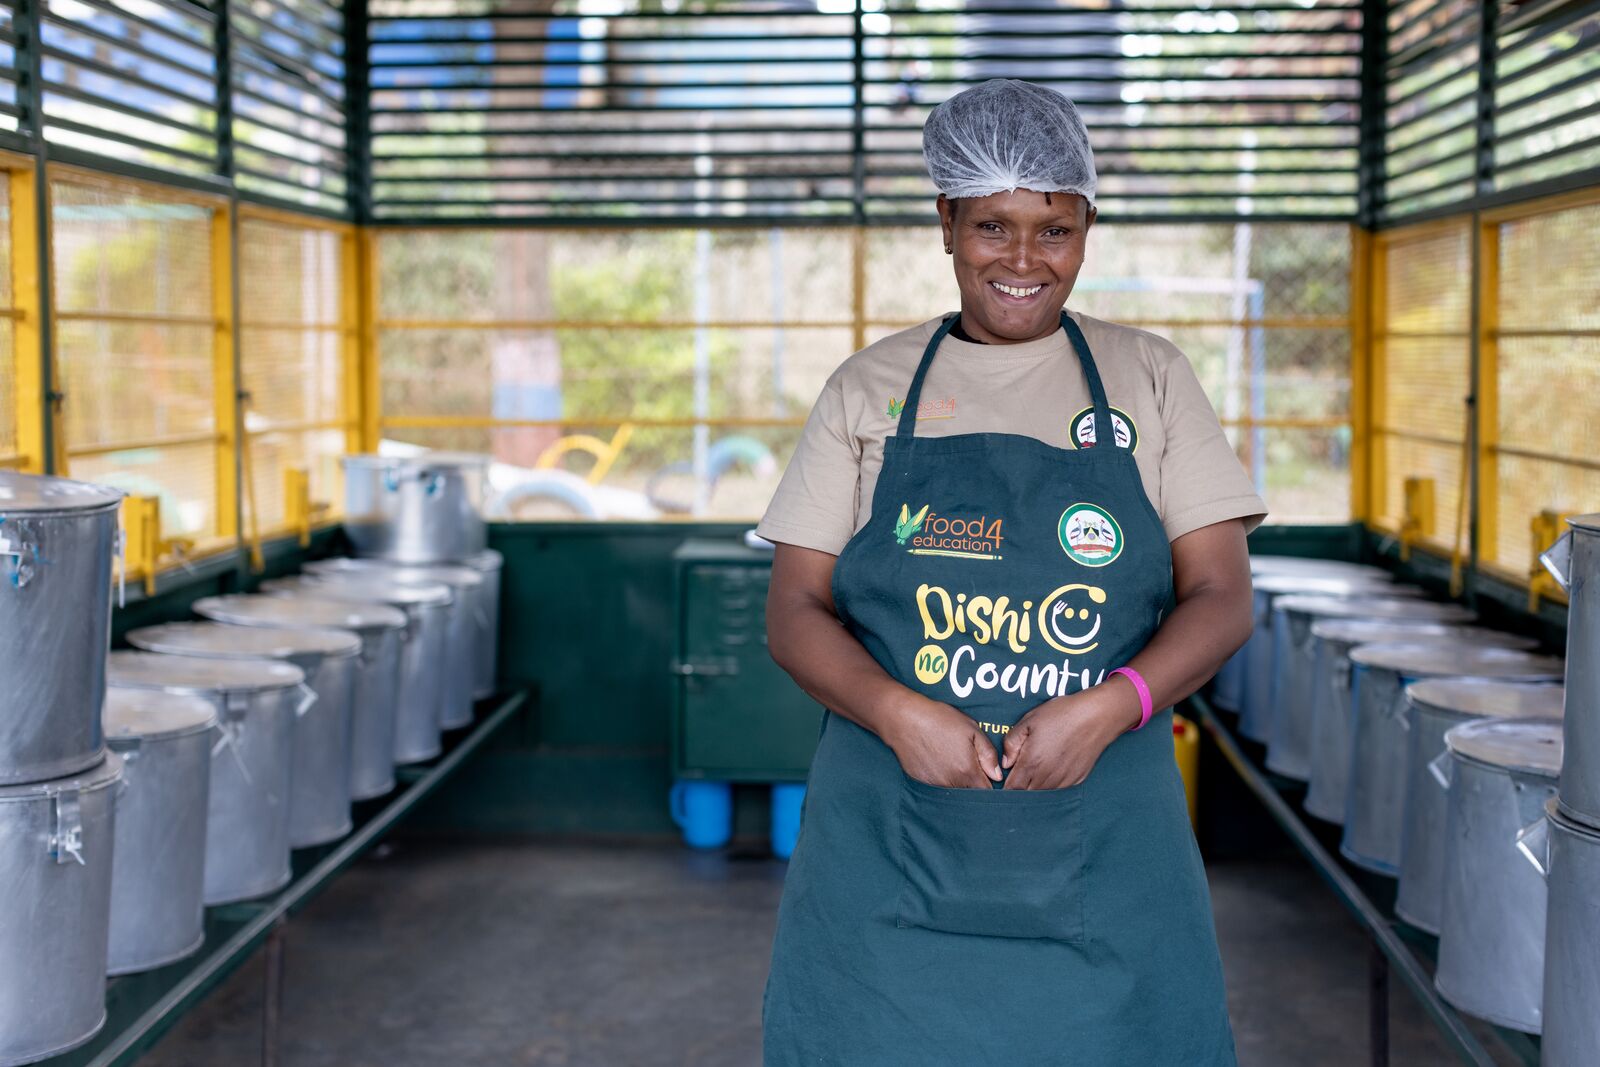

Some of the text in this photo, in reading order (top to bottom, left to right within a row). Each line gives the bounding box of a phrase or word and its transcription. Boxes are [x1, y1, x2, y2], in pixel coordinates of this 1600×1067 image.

[913, 534, 992, 552] education
[915, 583, 1033, 654] Dishi
[918, 652, 946, 673] na
